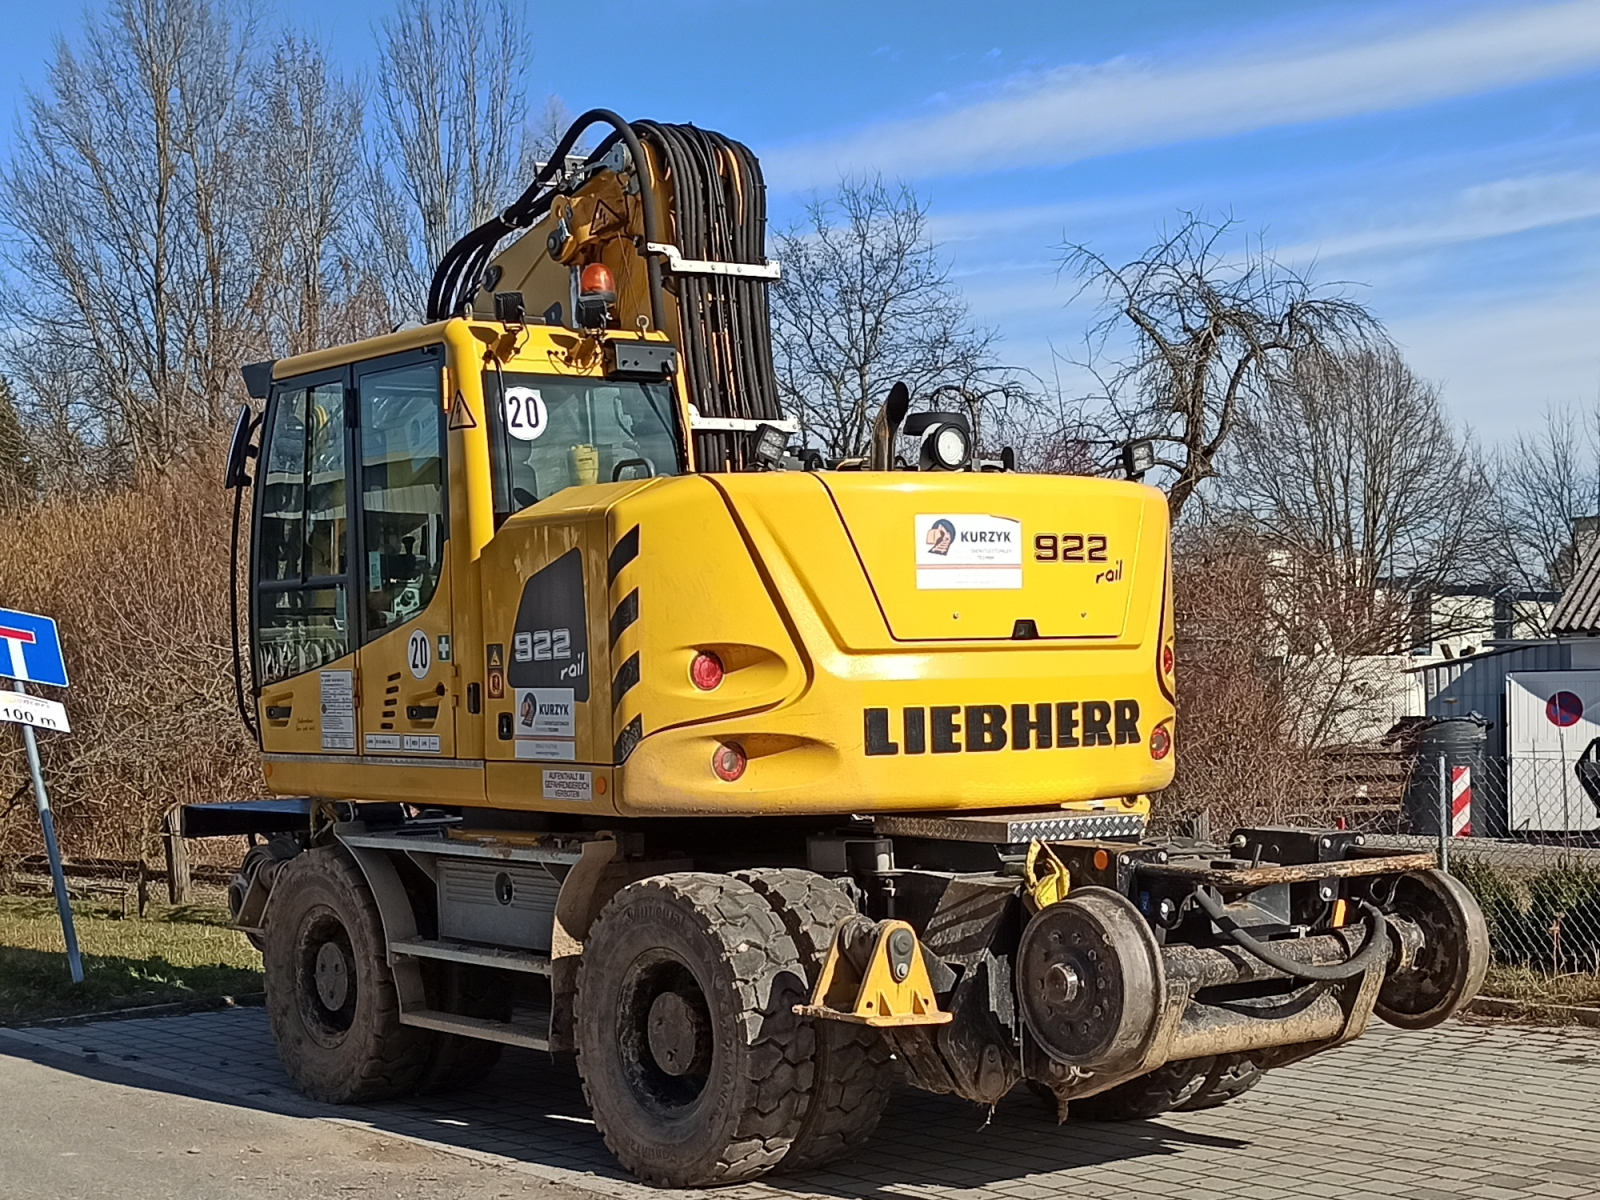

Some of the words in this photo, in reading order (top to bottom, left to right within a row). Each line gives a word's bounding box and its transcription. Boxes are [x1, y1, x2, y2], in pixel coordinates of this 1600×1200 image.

[508, 395, 540, 428] 20
[960, 531, 1012, 543] KURZYK
[1034, 533, 1108, 562] 922
[1095, 560, 1123, 584] rail
[411, 636, 428, 669] 20
[515, 628, 571, 662] 922
[560, 652, 585, 681] rail
[3, 707, 34, 723] 100
[40, 717, 56, 728] m
[539, 703, 569, 716] KURZYK
[864, 699, 1141, 756] LIEBHERR
